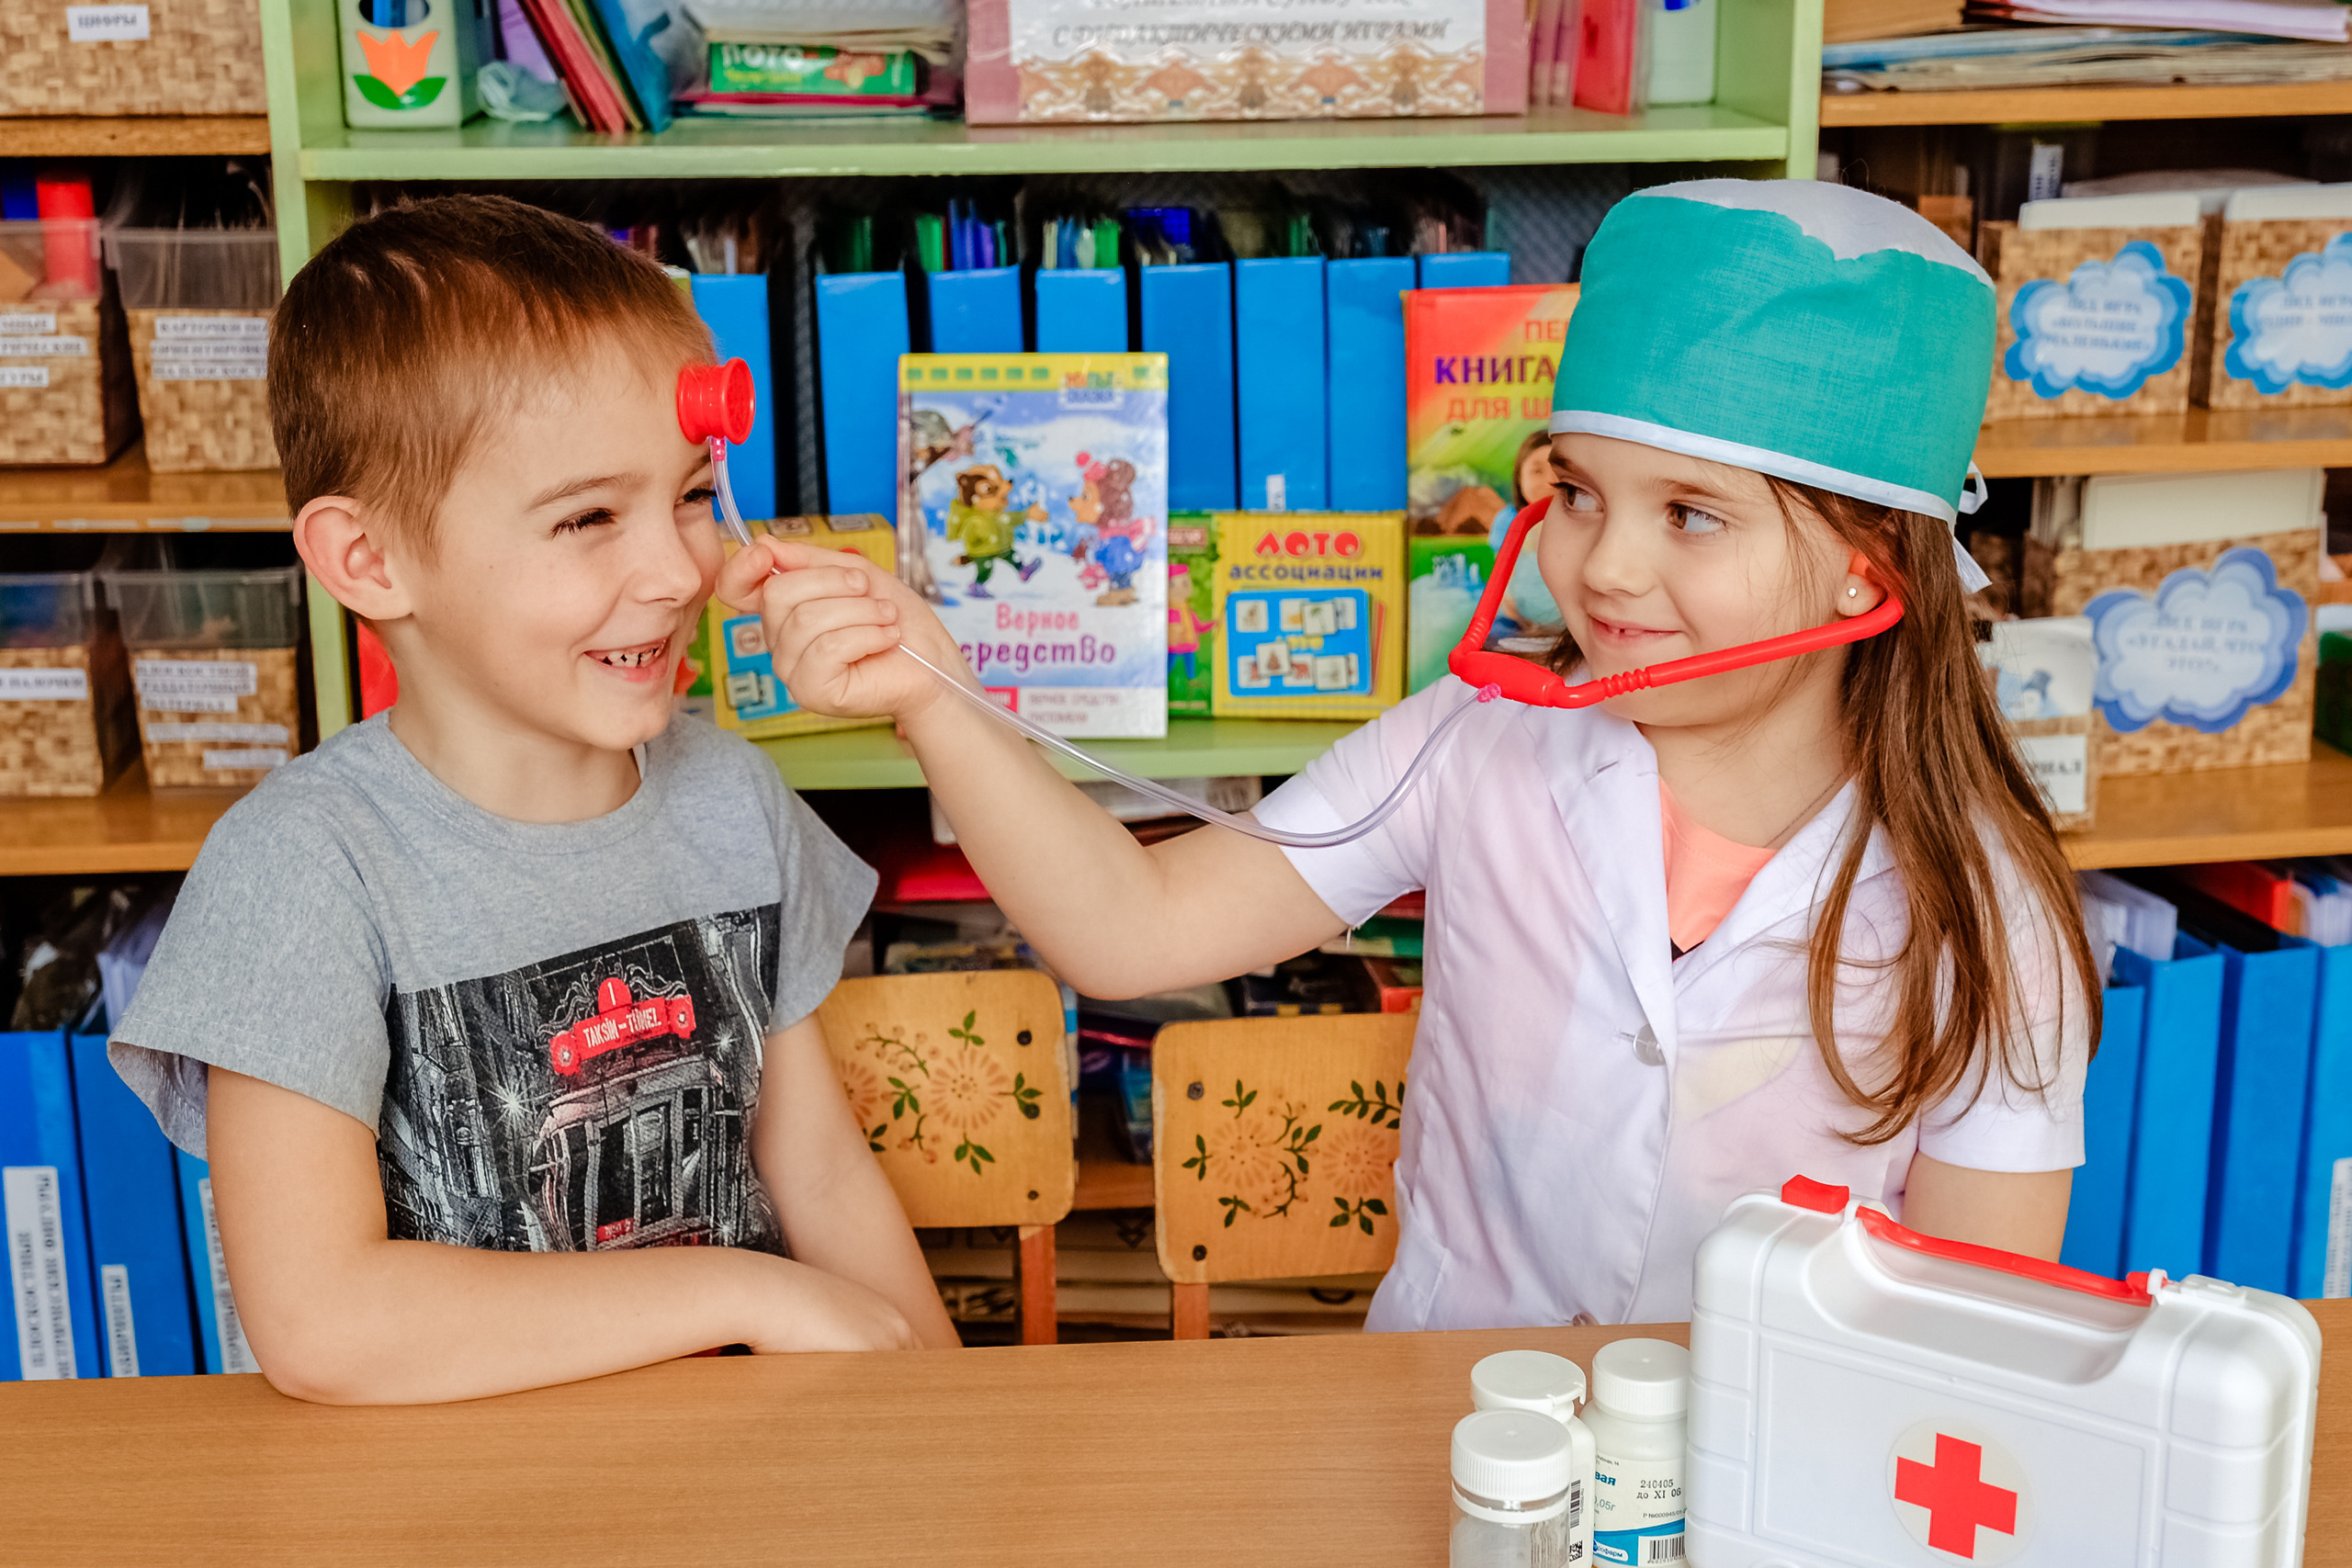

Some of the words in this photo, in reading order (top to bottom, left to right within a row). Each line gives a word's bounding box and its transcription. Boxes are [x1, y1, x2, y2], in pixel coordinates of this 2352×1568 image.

[1525, 321, 1569, 341] ПЕ
[1435, 357, 1555, 384] КНИГА
[1448, 398, 1510, 423] ДЛЯ
[1255, 531, 1360, 557] ЛОТО
[1229, 564, 1384, 581] ассоциации
[997, 603, 1080, 637] Верное
[960, 634, 1116, 672] средство
[1595, 1471, 1616, 1486] вая
[1640, 1479, 1674, 1489] 240405
[1654, 1490, 1666, 1499] XI
[1670, 1487, 1681, 1498] 06
